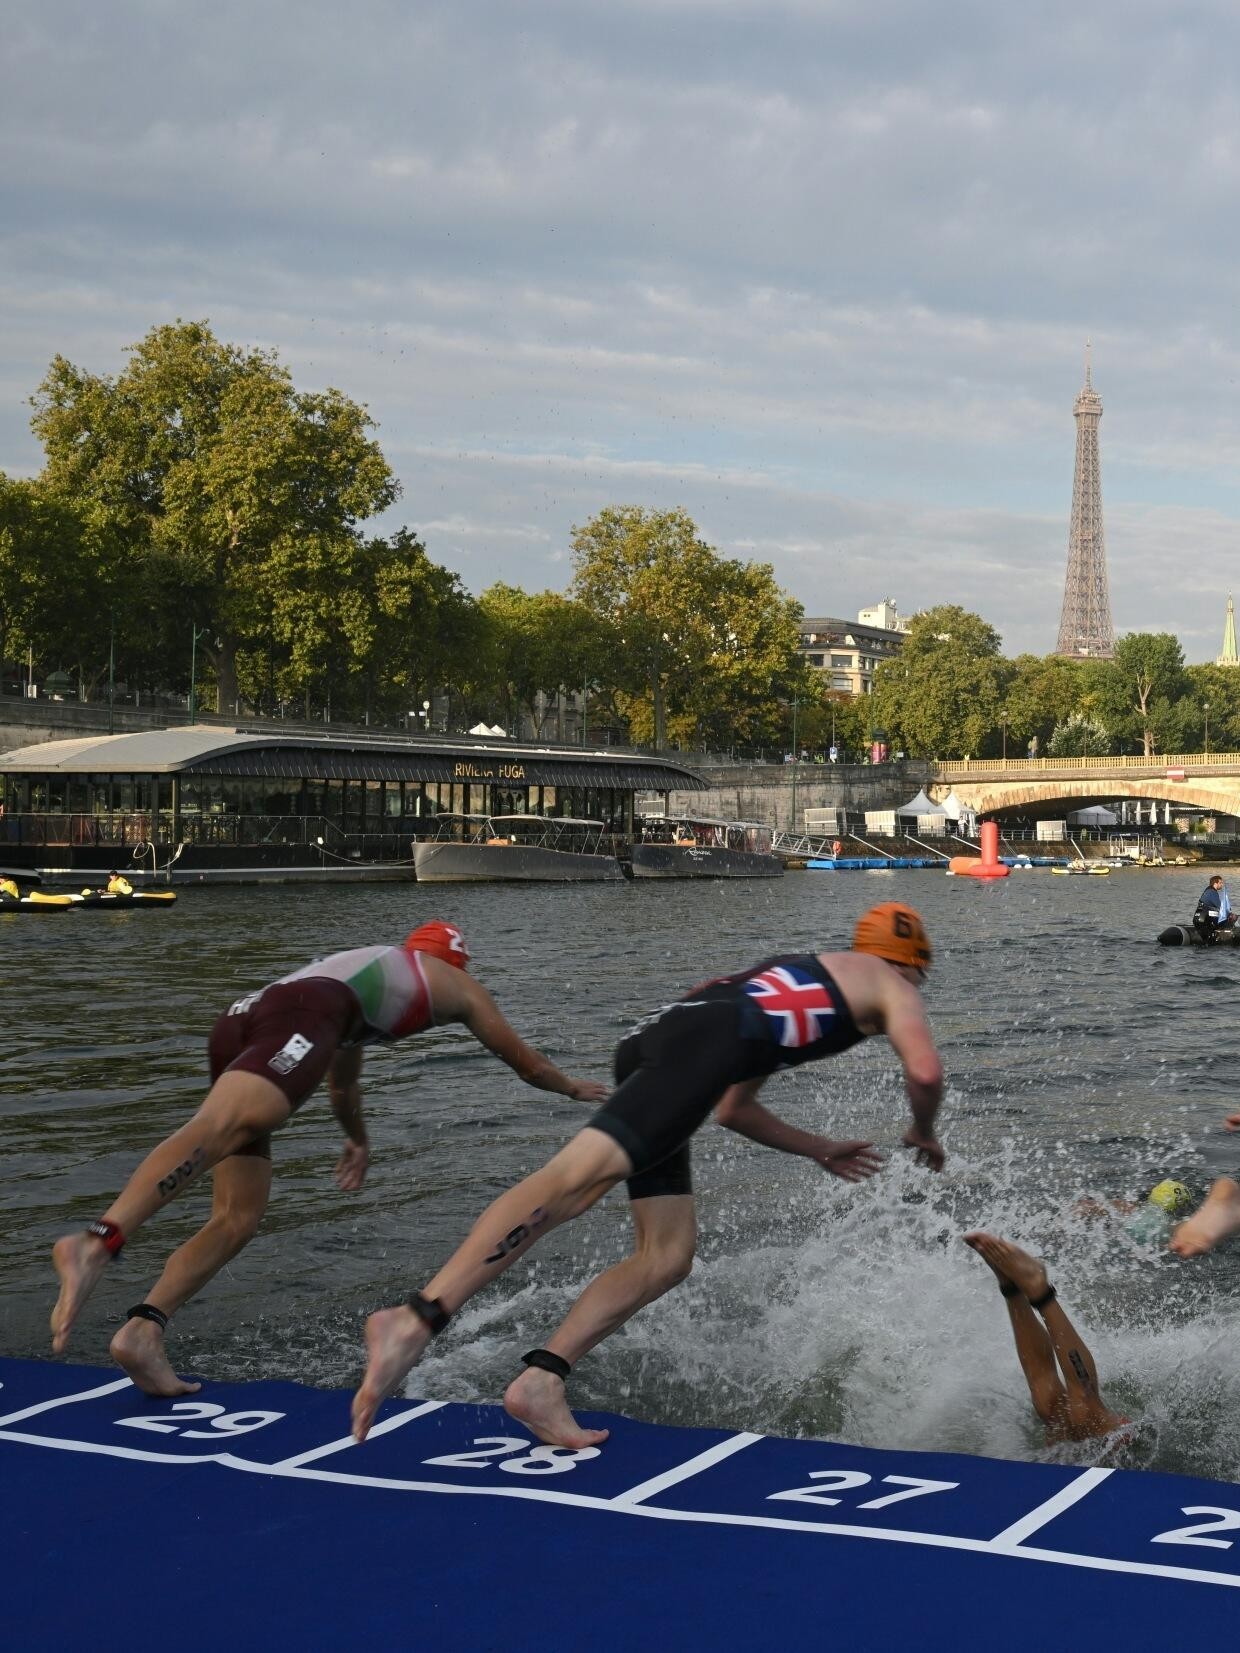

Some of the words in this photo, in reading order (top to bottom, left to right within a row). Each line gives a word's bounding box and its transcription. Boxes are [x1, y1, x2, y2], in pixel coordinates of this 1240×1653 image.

[498, 764, 525, 779] FUGA
[113, 1402, 287, 1439] 29
[420, 1436, 602, 1475] 28
[765, 1470, 961, 1510] 27
